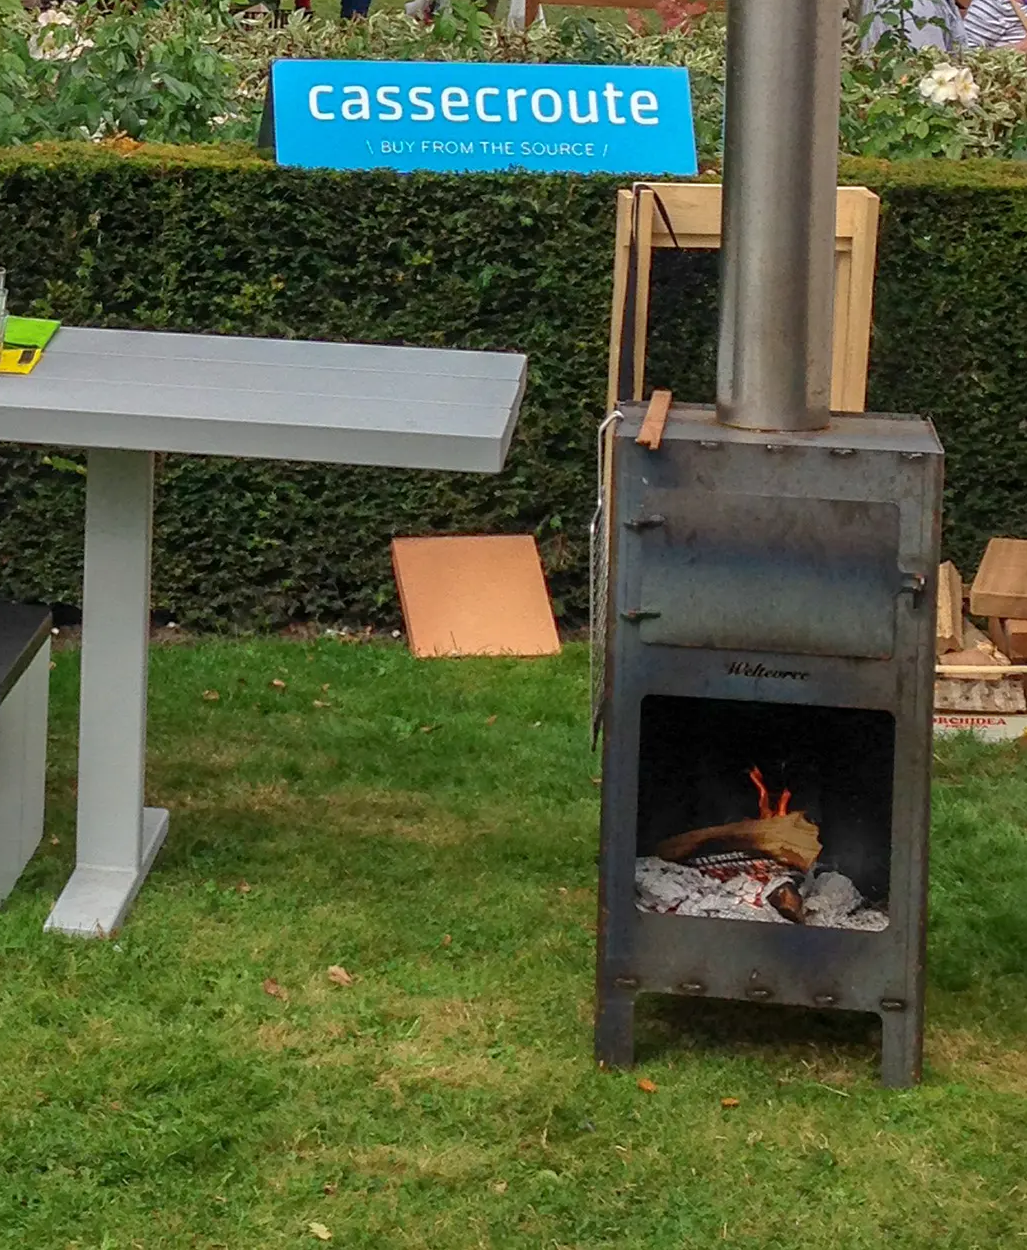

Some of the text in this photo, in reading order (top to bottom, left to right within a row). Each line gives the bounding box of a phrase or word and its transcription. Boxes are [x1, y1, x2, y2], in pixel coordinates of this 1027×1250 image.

[308, 82, 660, 126] cassecroute
[381, 140, 415, 154] BUY
[421, 141, 474, 154] FROM
[479, 141, 514, 155] THE
[520, 142, 595, 156] SOURCE
